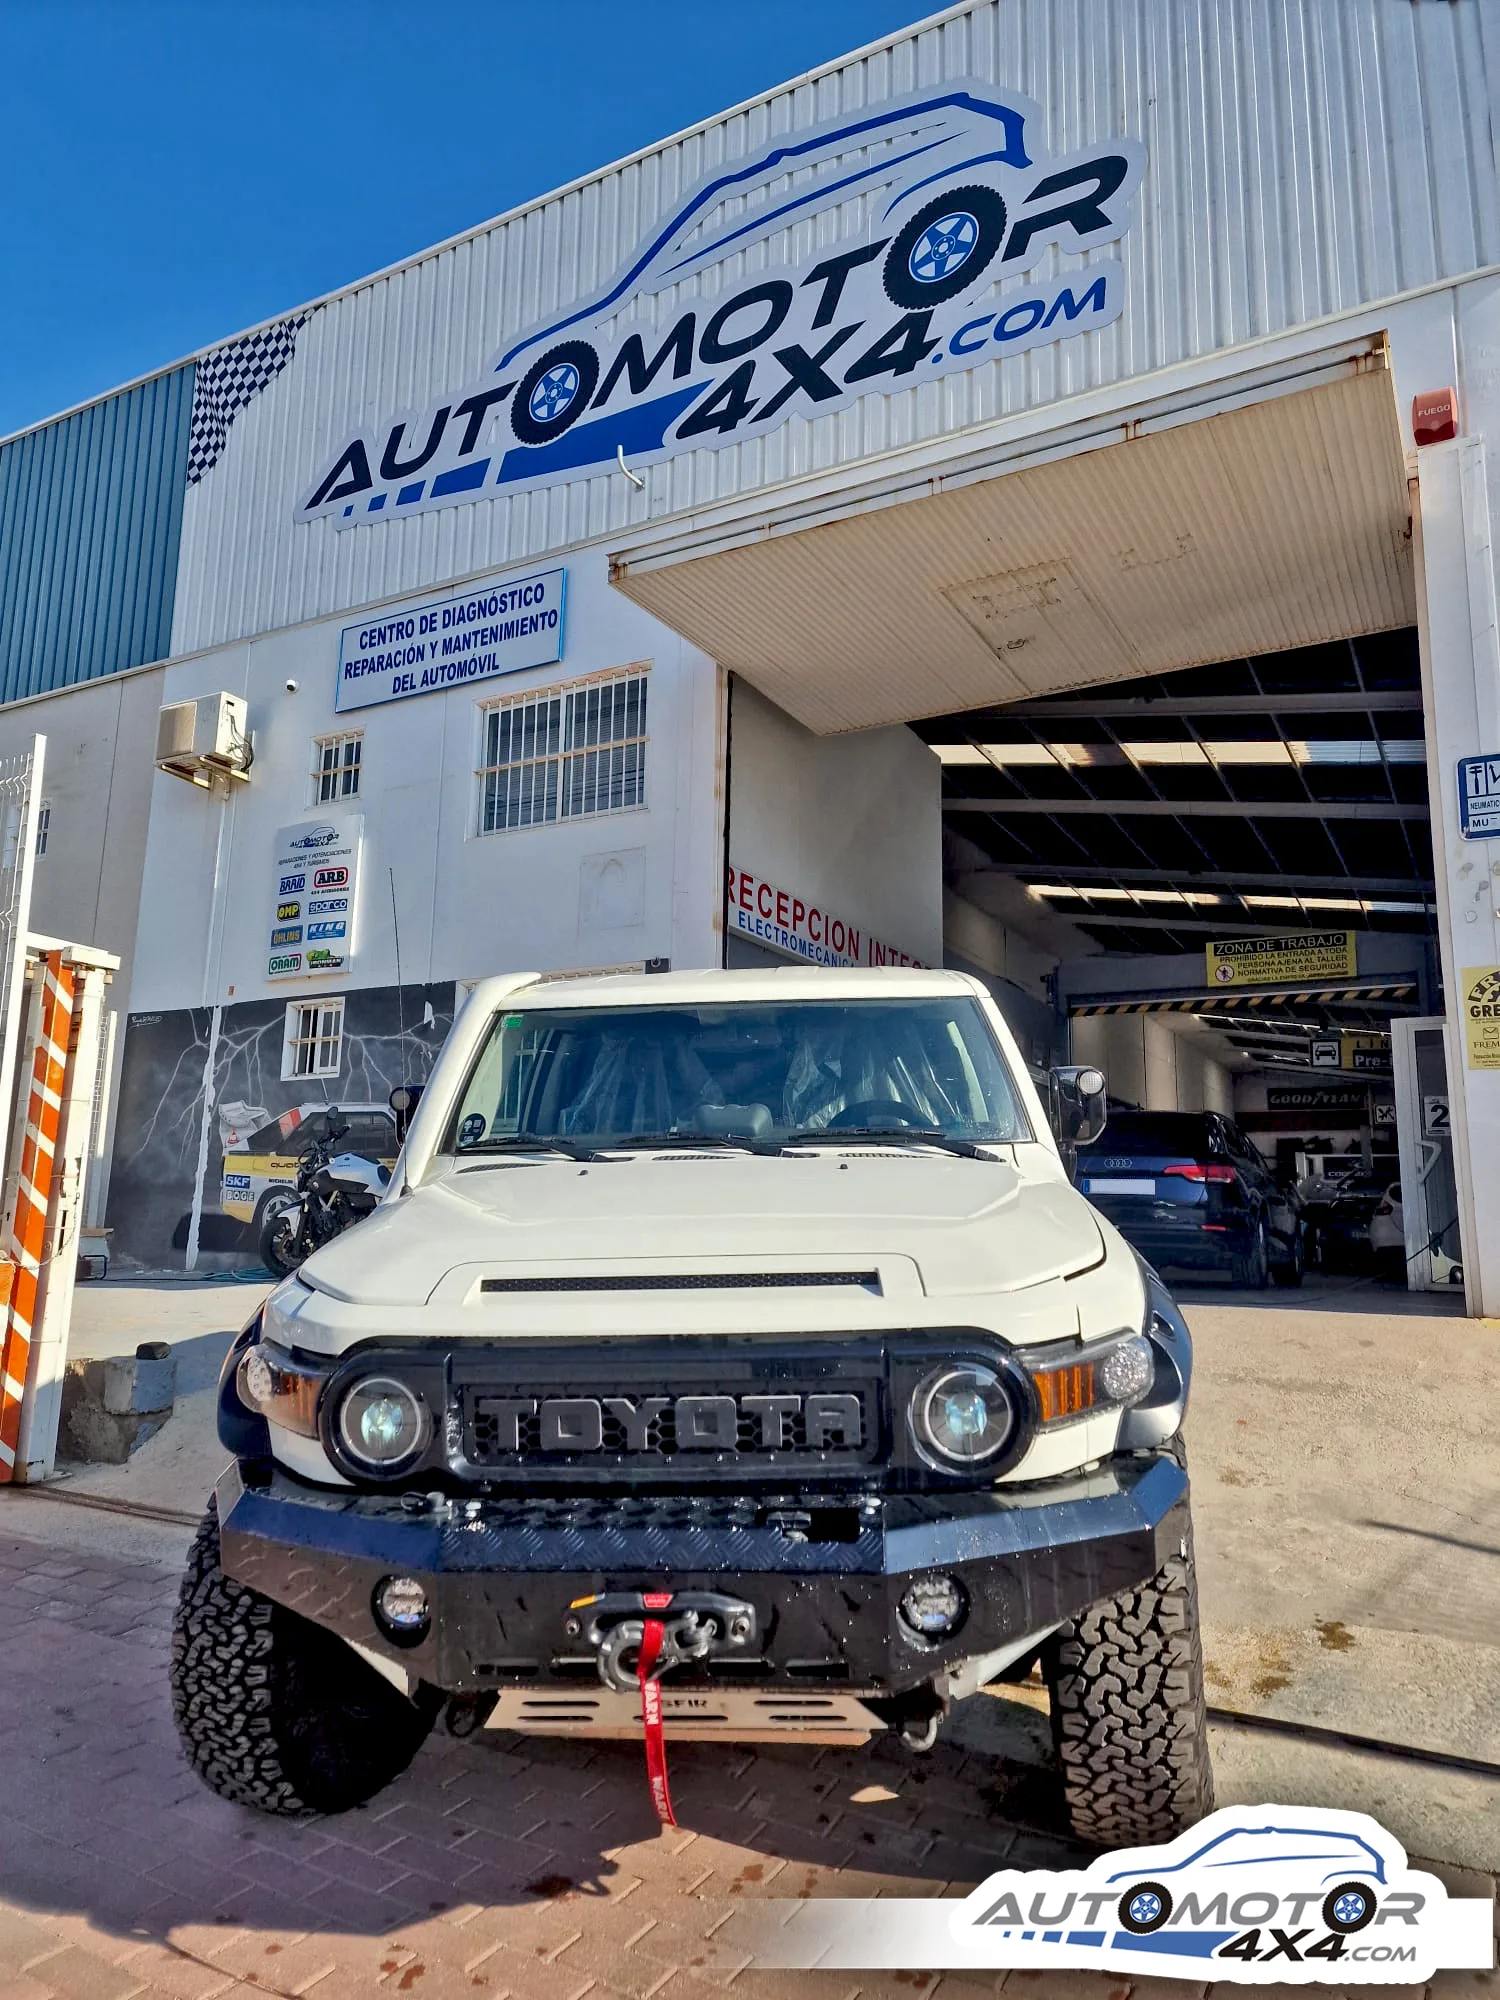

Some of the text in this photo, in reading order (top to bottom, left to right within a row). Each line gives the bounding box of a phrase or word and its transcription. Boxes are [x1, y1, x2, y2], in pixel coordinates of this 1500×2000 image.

[304, 155, 1129, 511] AUTOMOTOR
[1418, 404, 1450, 417] FUEGO
[359, 583, 545, 650] CENTRO DE DIAGNÓSTICO
[344, 608, 558, 680] REPARACIÓN Y MANTENIMIENTO
[392, 653, 500, 695] DEL AUTOMÓVIL
[1472, 818, 1489, 828] MU
[289, 833, 340, 848] AUTOMOTOR
[279, 876, 306, 893] BRAID
[317, 870, 345, 885] ARB
[278, 904, 298, 919] OMP
[310, 899, 347, 912] sparco
[728, 866, 860, 961] RECEPCION
[309, 921, 345, 932] KING
[738, 910, 855, 968] ELECTROMECANIC
[1216, 934, 1344, 955] ZONA DE TRABAJO
[1219, 953, 1264, 963] PROHIBIDO
[1277, 949, 1316, 959] ENTRADA
[1324, 946, 1348, 954] TODA
[1237, 960, 1276, 969] PERSONA
[1277, 957, 1303, 966] AJENA
[1317, 954, 1348, 962] TALLER
[271, 957, 299, 971] ORAM
[1238, 967, 1284, 977] NORMATIVA
[1286, 965, 1297, 973] DE
[1299, 962, 1348, 972] SEGURIDAD
[1270, 1090, 1361, 1105] GOODYEAR
[1430, 1104, 1450, 1128] 2
[226, 1175, 250, 1188] SKF
[226, 1189, 255, 1201] BOGE
[479, 1394, 862, 1451] TOYOTA
